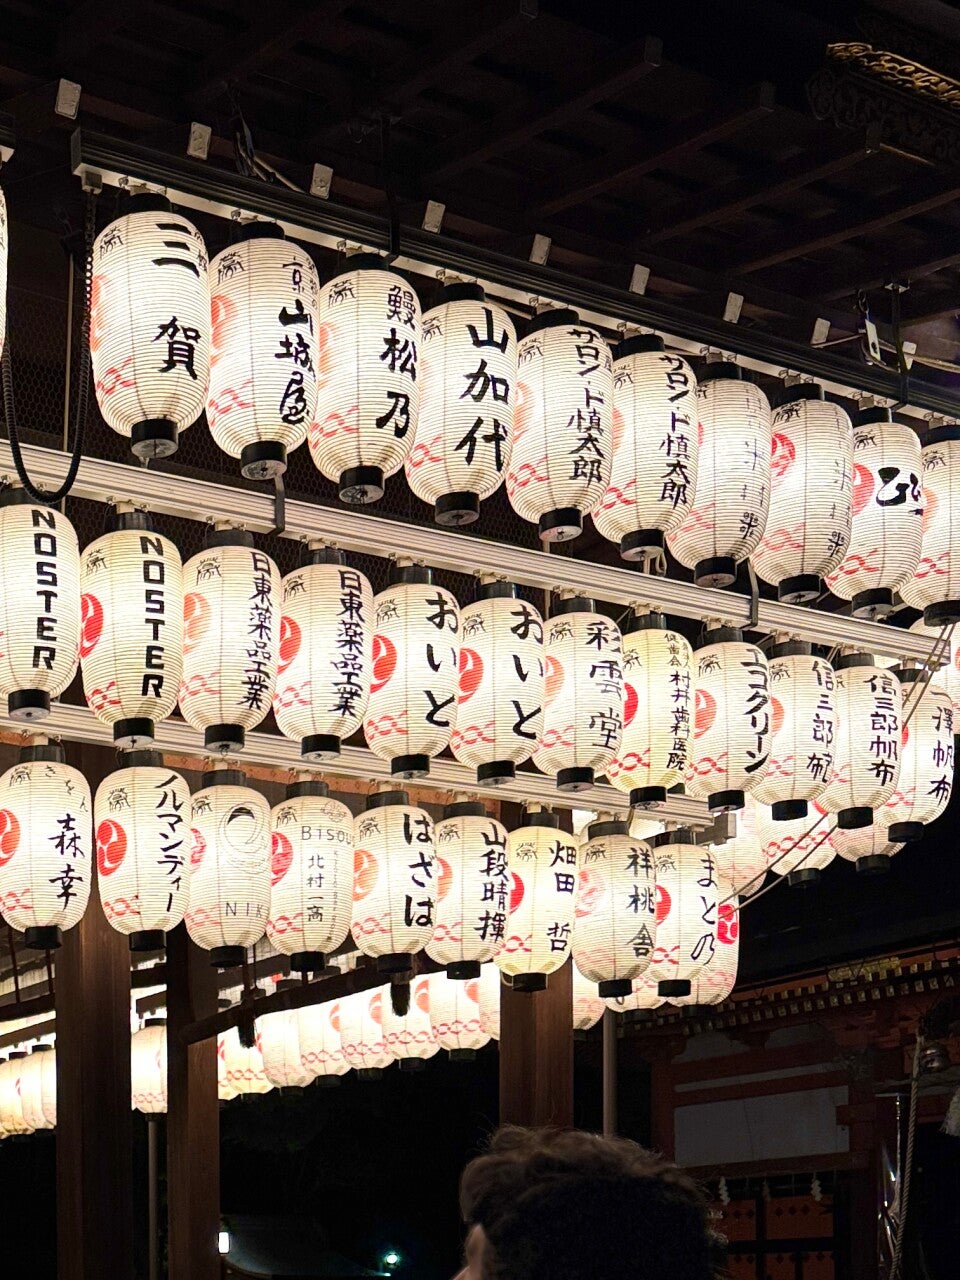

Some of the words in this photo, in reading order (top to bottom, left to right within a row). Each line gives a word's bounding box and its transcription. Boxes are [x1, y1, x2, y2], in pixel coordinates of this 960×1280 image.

[454, 305, 511, 473] 山加代
[31, 508, 59, 671] NOSTER
[139, 535, 166, 699] NOSTER
[236, 550, 274, 711] 日東薬品工業
[327, 568, 366, 720] 日東薬品工業
[422, 590, 460, 728] おいと
[509, 602, 545, 740] おいと
[585, 619, 623, 752] 彩雲堂
[667, 670, 692, 772] 村井歯科医院
[740, 648, 770, 774] エコクリーン
[863, 673, 899, 787] 信三郎帆布
[47, 812, 86, 911] 森幸
[154, 774, 186, 913] ノルマンディー
